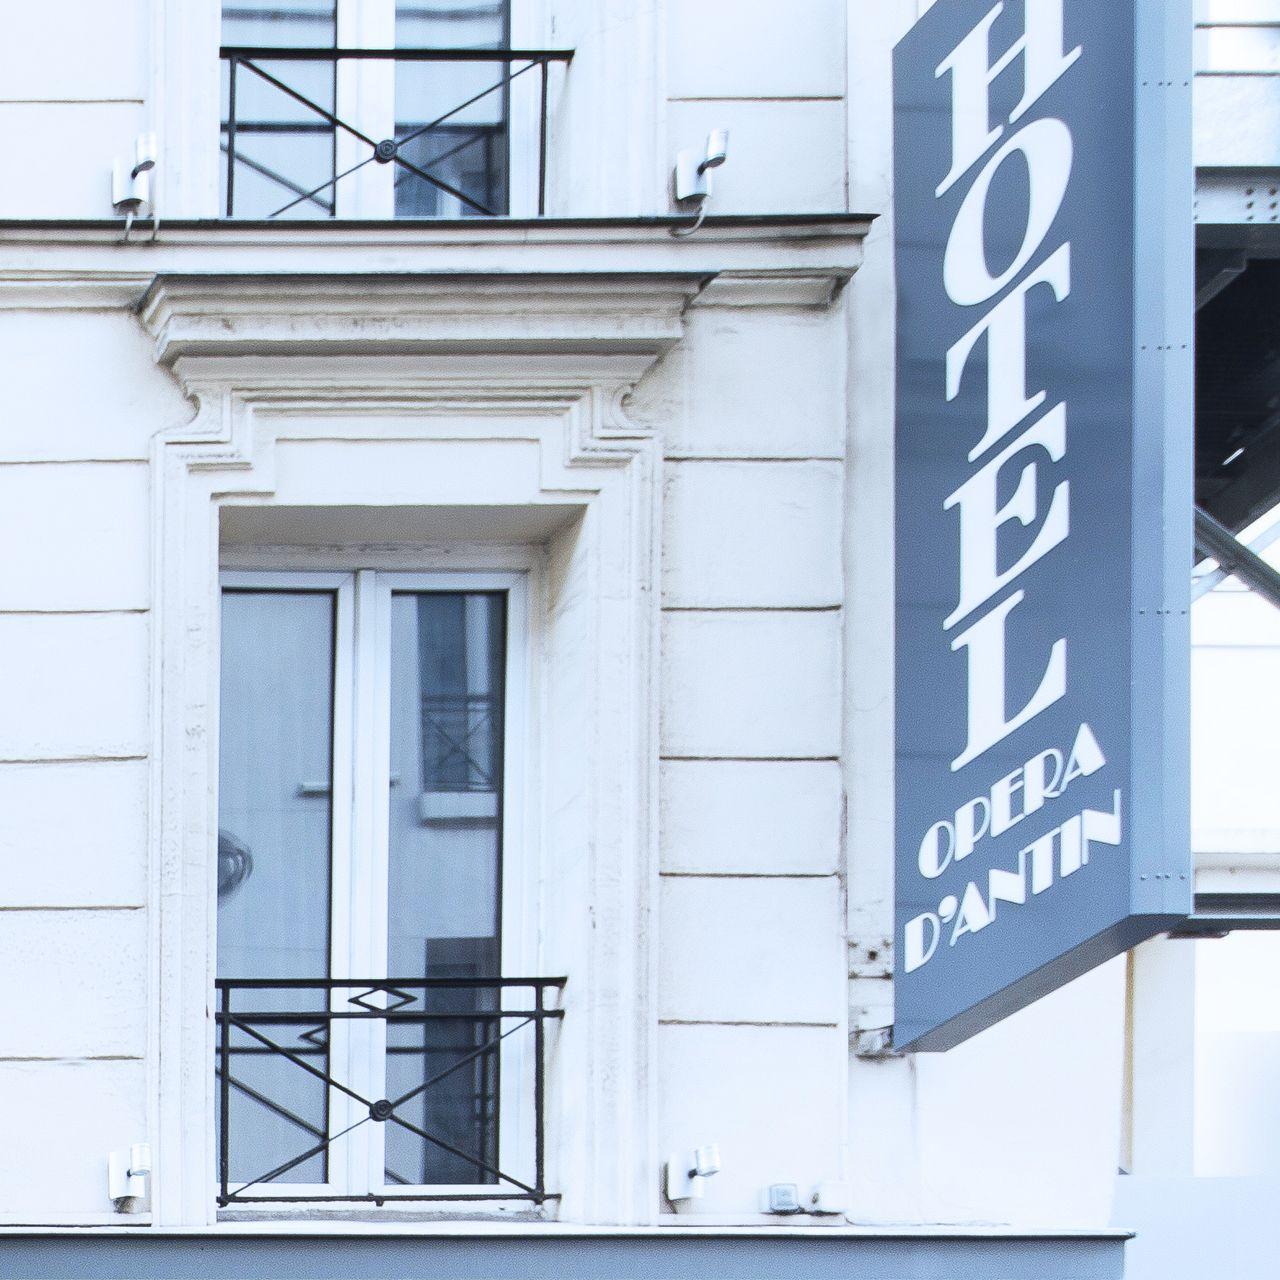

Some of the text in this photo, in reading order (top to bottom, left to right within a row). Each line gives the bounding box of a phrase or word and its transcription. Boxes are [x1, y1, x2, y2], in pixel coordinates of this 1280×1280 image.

[933, 0, 1083, 774] HOTEL
[904, 788, 1122, 974] D'ANTIN
[918, 722, 1107, 879] OPERA
